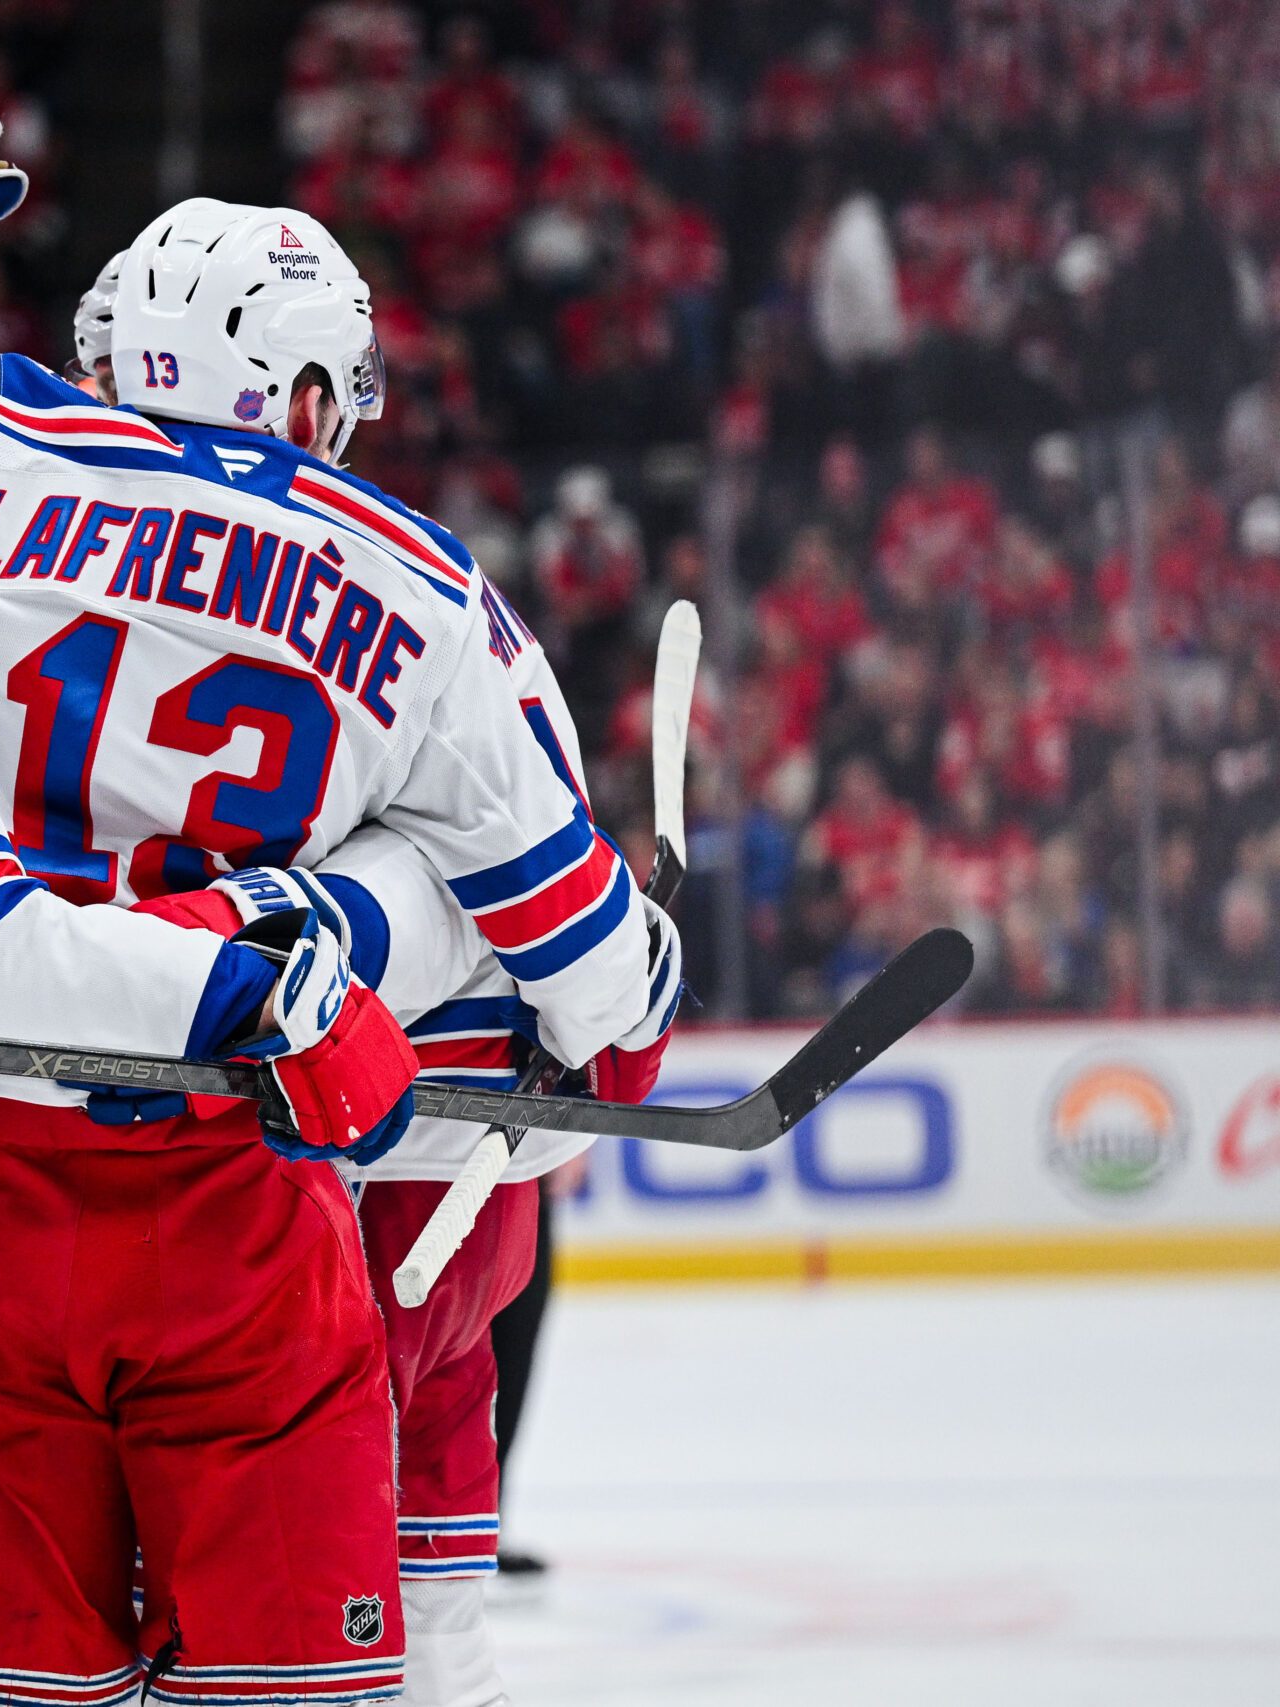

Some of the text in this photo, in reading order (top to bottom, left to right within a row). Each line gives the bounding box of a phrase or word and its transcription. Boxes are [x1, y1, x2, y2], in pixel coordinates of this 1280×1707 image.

[268, 251, 320, 267] Benjamin
[281, 267, 316, 281] Moore
[142, 350, 180, 390] 13
[6, 610, 341, 904] 13
[22, 1050, 171, 1081] XF GHOST
[351, 1607, 377, 1636] NHL
